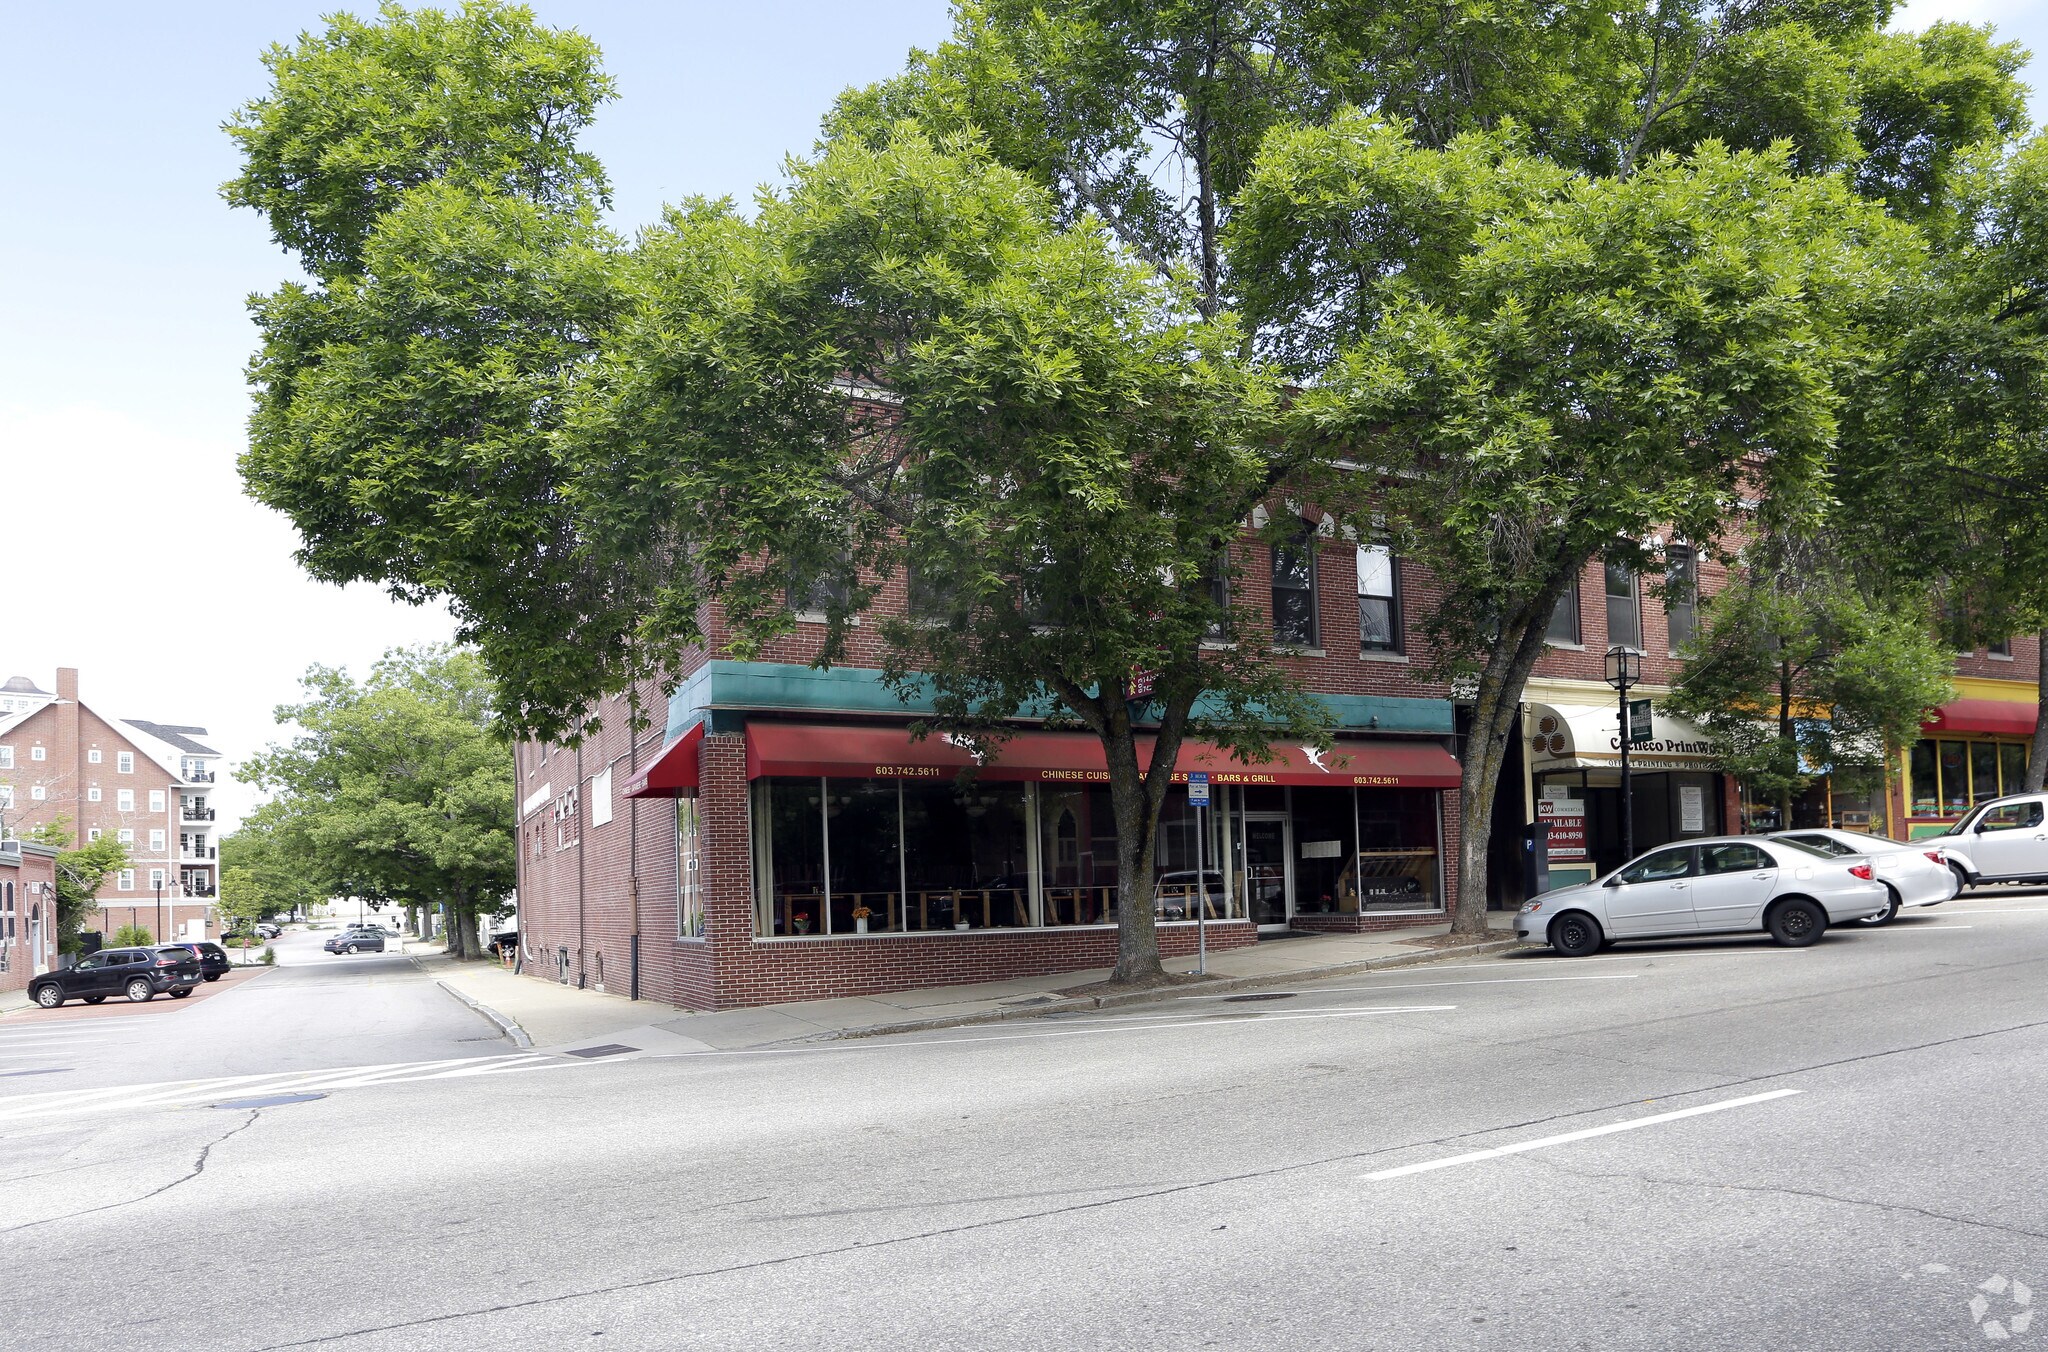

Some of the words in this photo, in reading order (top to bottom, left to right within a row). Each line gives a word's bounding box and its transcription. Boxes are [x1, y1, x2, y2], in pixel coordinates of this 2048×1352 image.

[875, 766, 940, 776] 603.742.5611
[1041, 770, 1084, 779] CHINESE
[1086, 771, 1111, 780] CUIS
[1217, 774, 1241, 782] BARS
[1251, 775, 1276, 783] GRILL
[1353, 776, 1399, 784] 603.742.5611
[1540, 804, 1553, 815] KW
[1548, 831, 1583, 840] 3-610-8950
[1526, 839, 1533, 850] P
